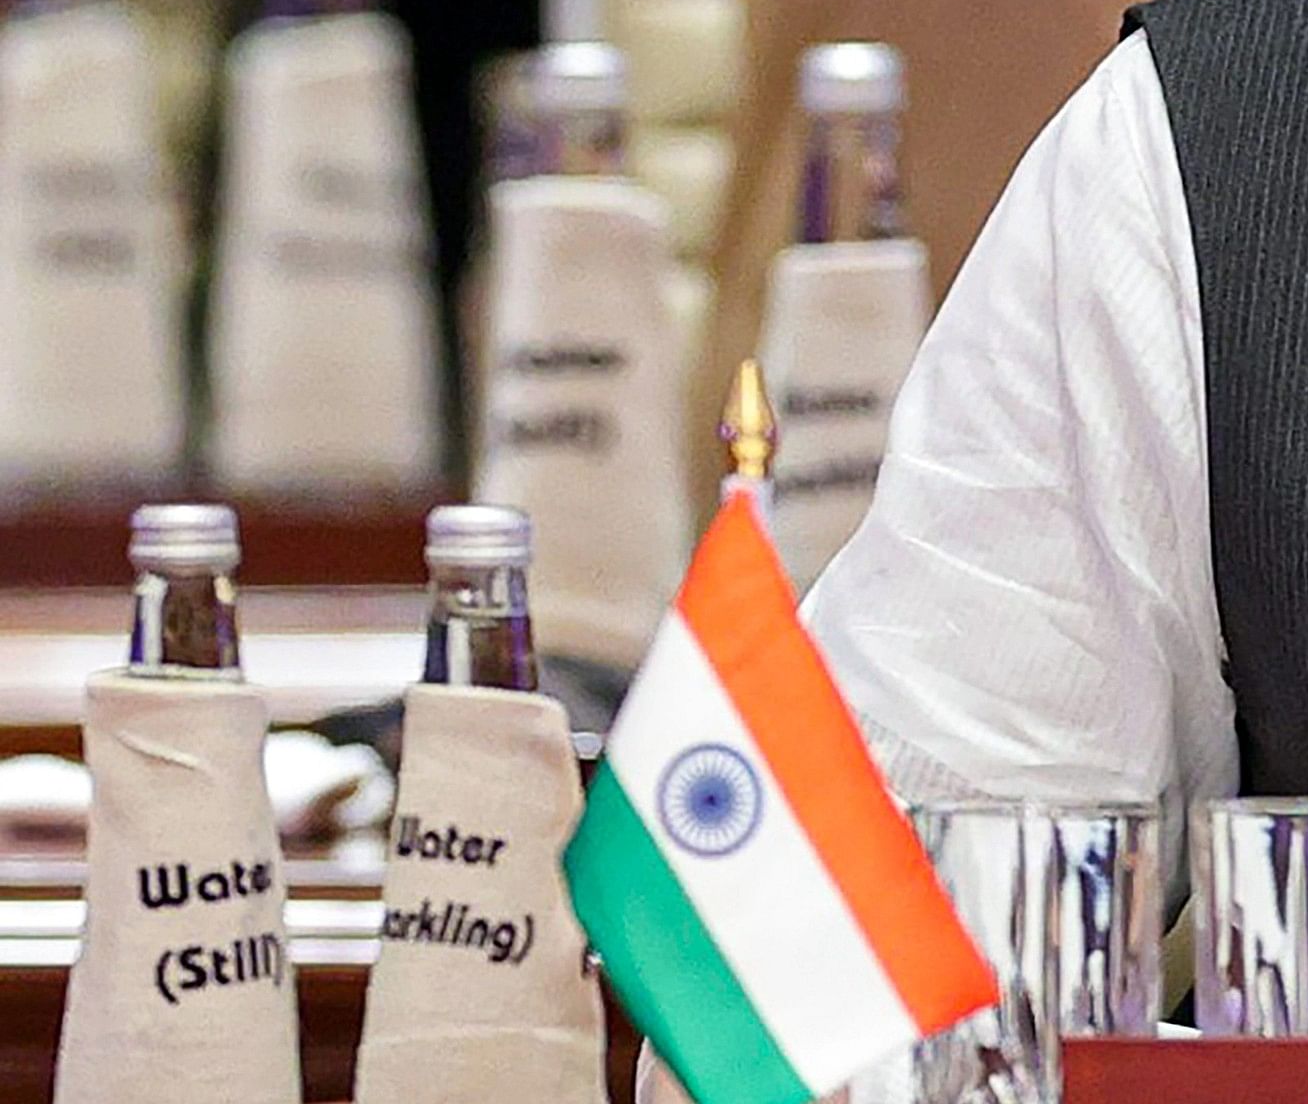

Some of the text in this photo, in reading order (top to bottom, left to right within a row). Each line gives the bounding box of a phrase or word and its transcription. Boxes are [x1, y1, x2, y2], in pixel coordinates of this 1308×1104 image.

[139, 861, 272, 908] Wate
[384, 899, 533, 963] arkling)
[156, 933, 281, 1004] (Still)
